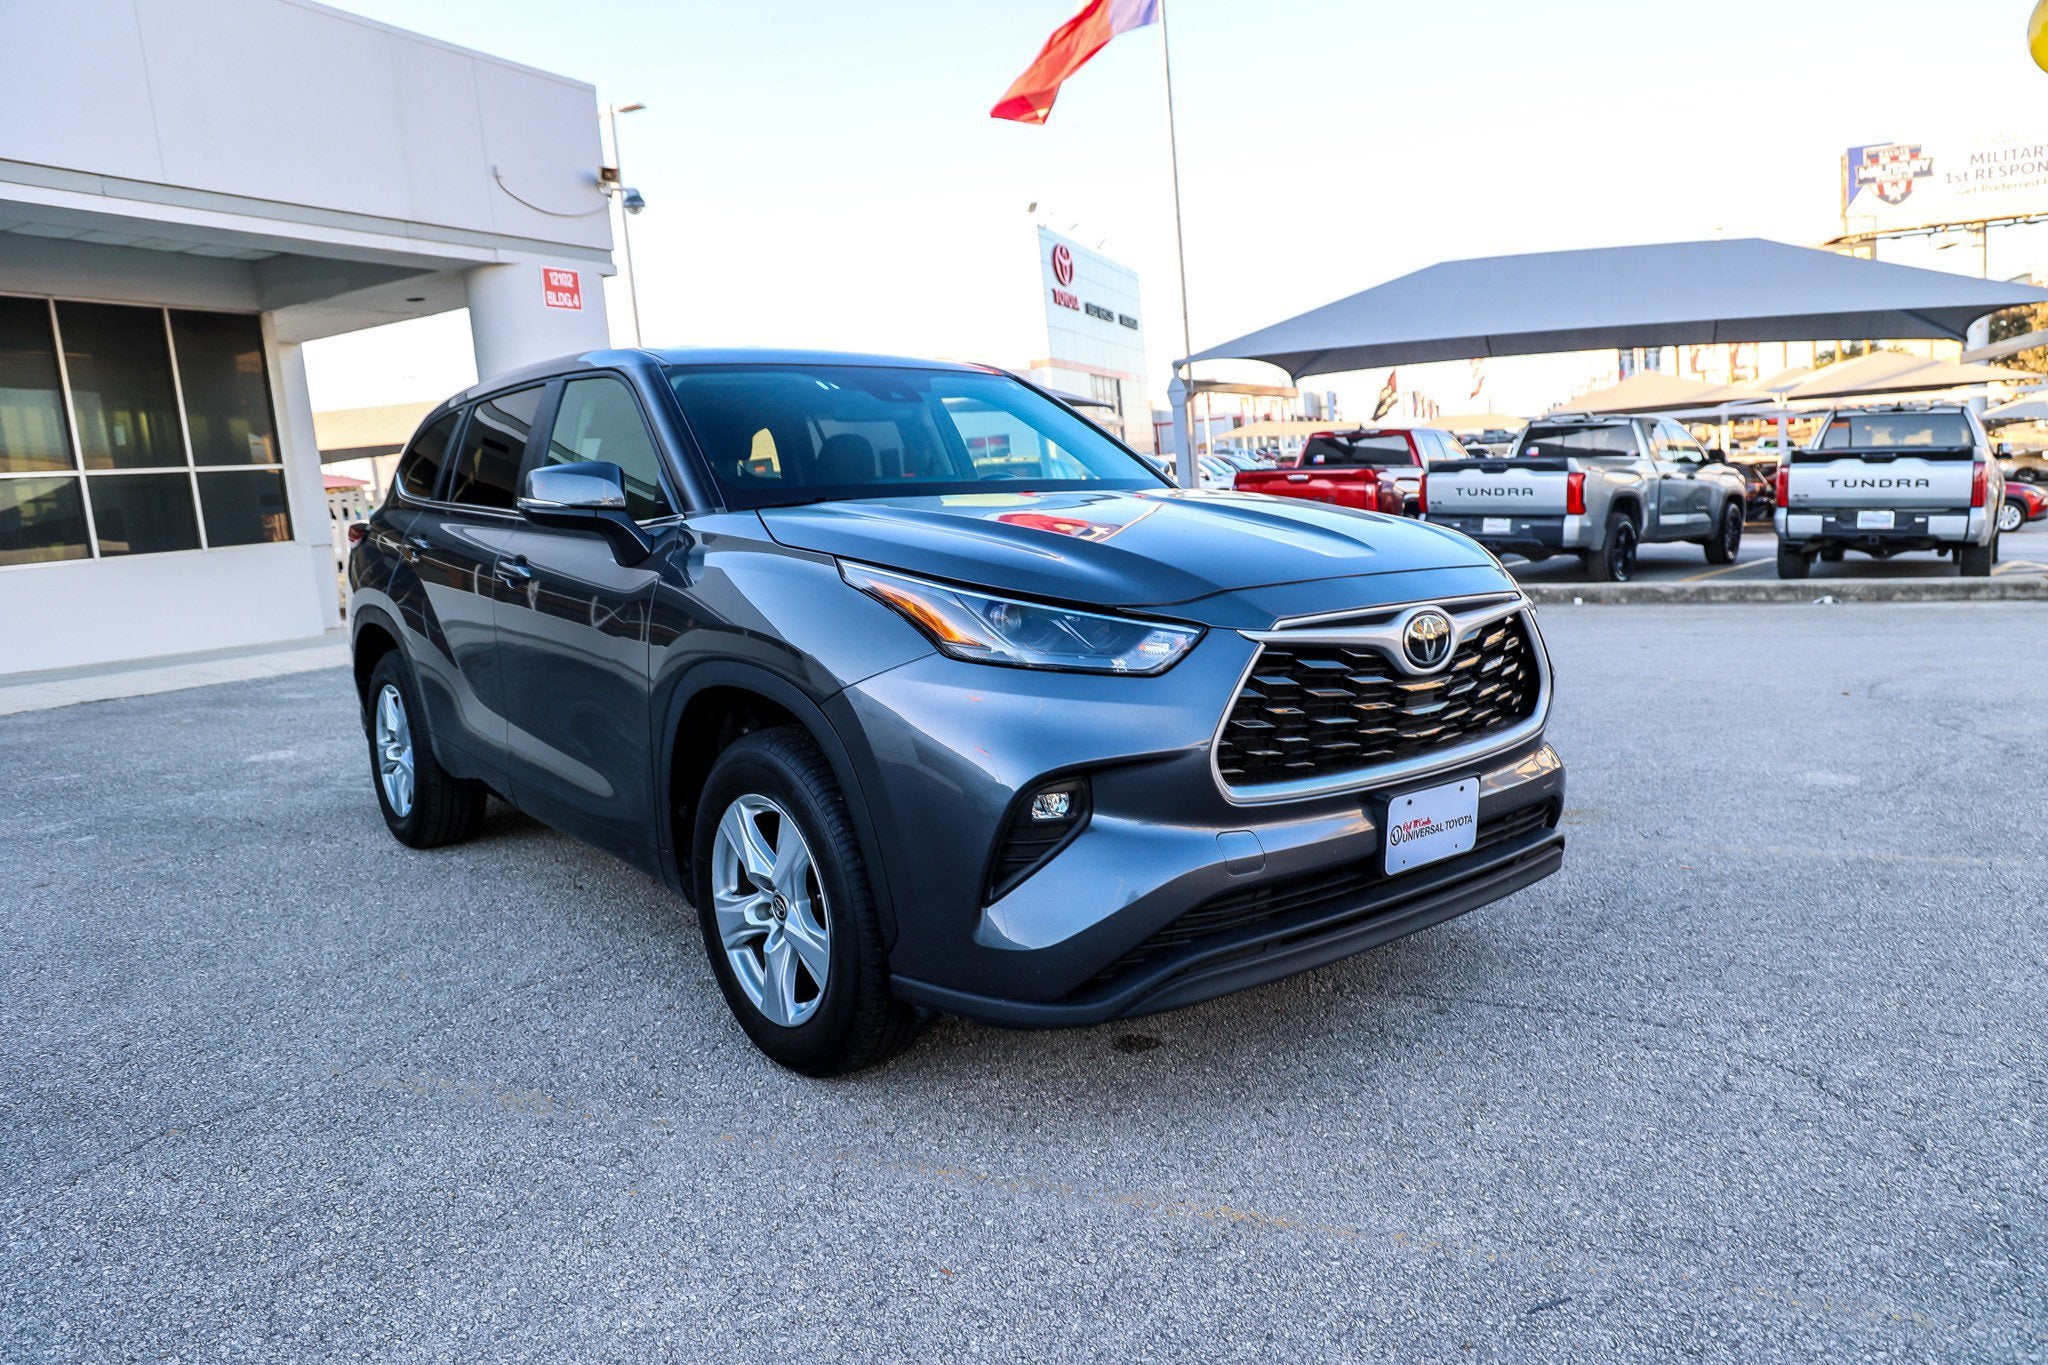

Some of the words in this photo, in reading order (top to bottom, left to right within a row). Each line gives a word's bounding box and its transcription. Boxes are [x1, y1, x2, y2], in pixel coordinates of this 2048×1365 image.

[1970, 144, 2048, 165] MILITAR
[1946, 172, 1968, 184] 1st
[548, 271, 575, 288] 12102
[1826, 478, 1929, 488] TUNDRA
[1454, 487, 1534, 497] TUNDRA
[1402, 822, 1444, 842] UNIVERSAL
[1445, 814, 1473, 831] TOYOTA
